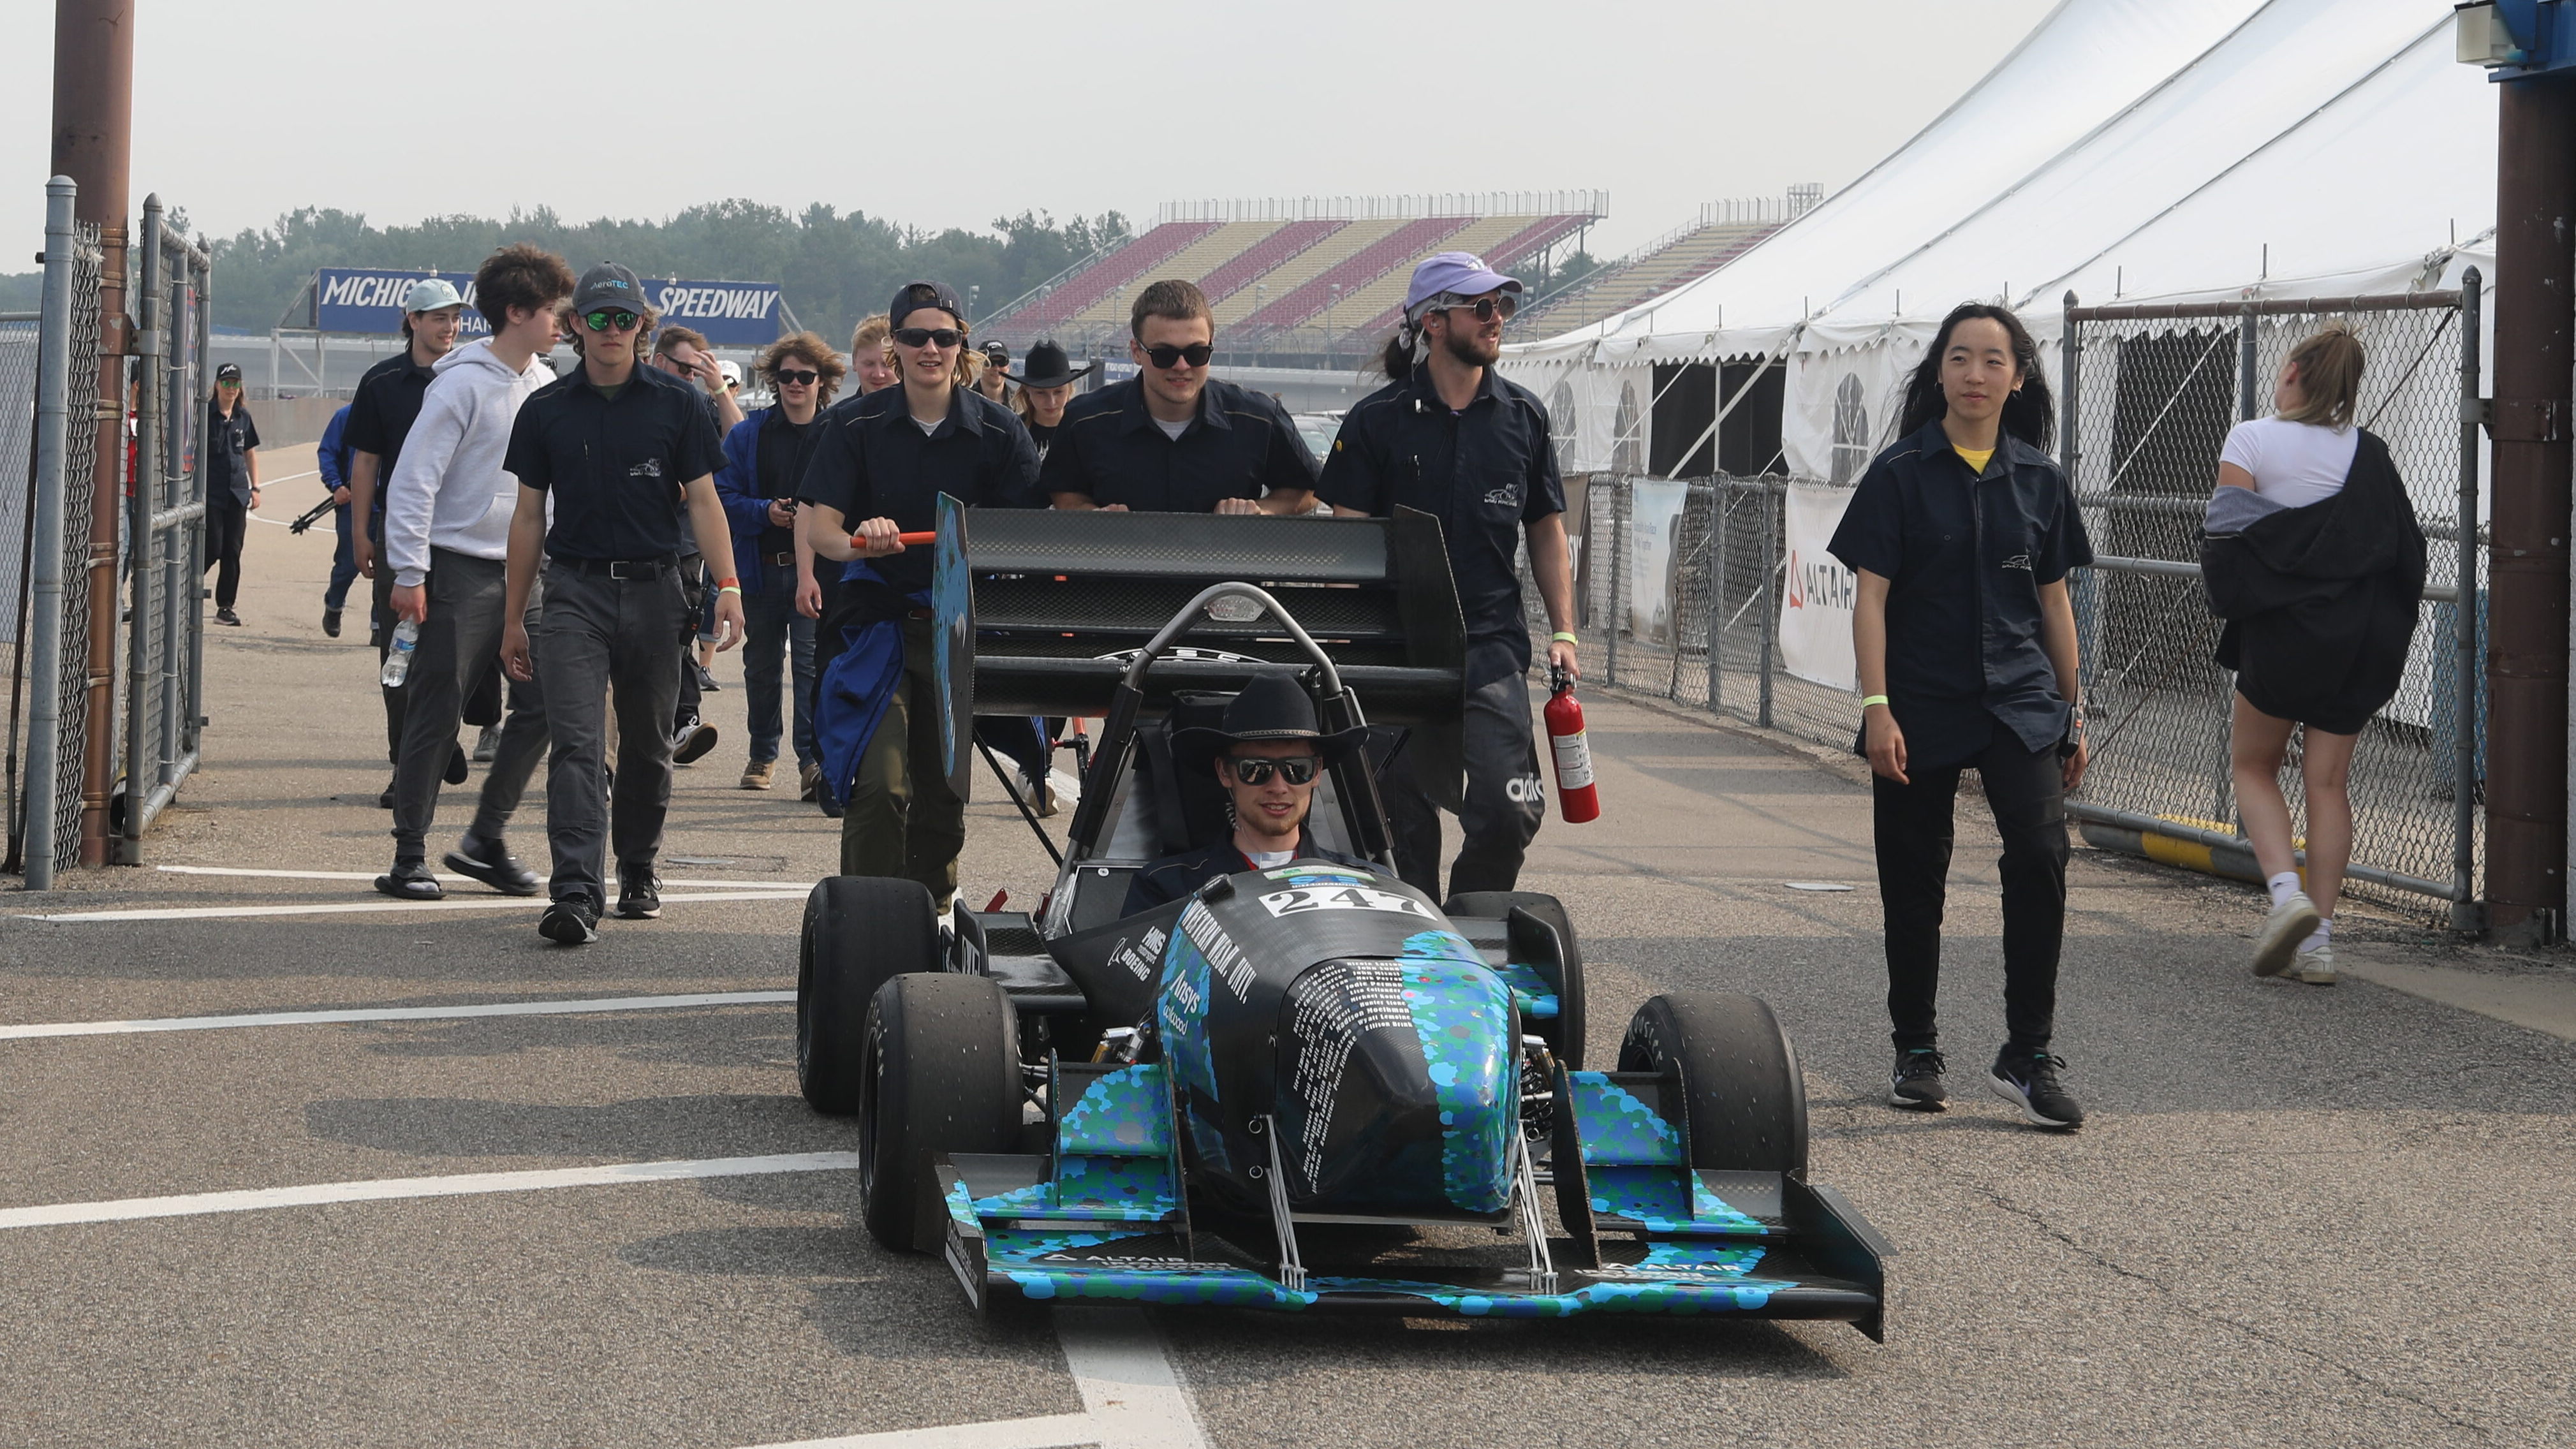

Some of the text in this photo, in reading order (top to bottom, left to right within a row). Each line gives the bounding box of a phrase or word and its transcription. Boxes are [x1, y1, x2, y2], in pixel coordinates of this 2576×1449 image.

[321, 276, 779, 319] MICHIG SPEEDWAY
[1806, 563, 1853, 611] ALTAIR
[1269, 888, 1423, 917] 247
[1142, 926, 1167, 955] HMS
[1181, 899, 1257, 1004] WESTERN WASH. UNIV.
[1121, 948, 1151, 982] BOEING
[1169, 969, 1200, 1014] Ansys
[1299, 973, 1318, 990] David
[1350, 994, 1378, 1003] Michael
[1336, 1010, 1364, 1033] Madison
